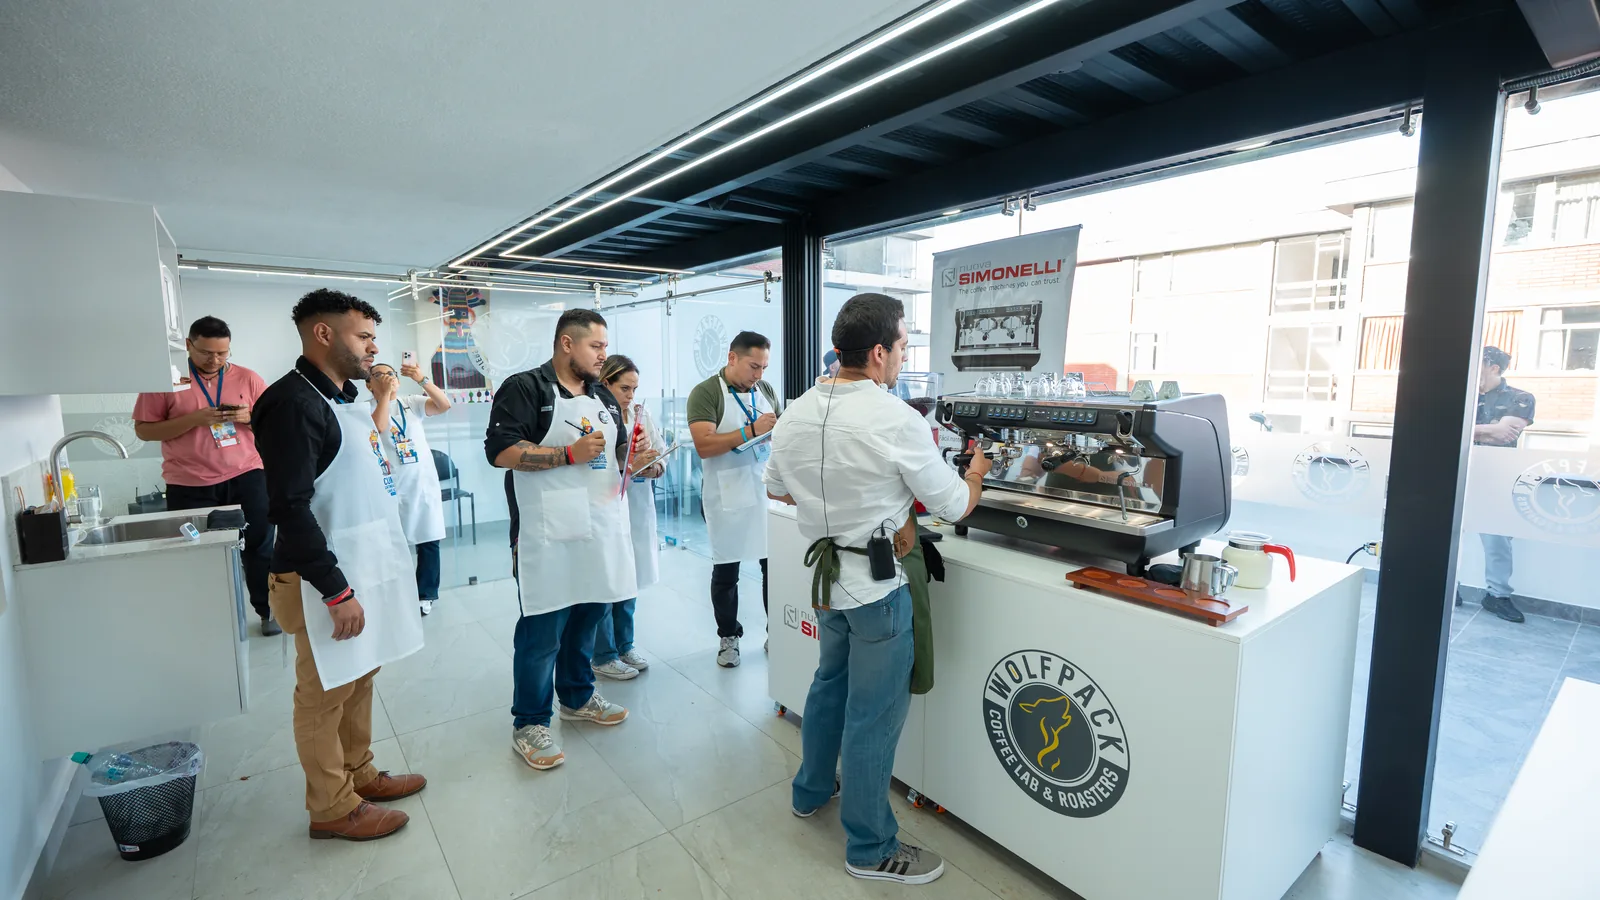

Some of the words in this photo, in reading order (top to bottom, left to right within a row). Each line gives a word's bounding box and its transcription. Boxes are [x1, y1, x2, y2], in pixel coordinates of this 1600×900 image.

[958, 259, 1062, 286] SIMONELLI
[960, 261, 991, 273] nuova
[970, 286, 987, 294] coffee
[988, 282, 1016, 291] machines
[1016, 281, 1028, 289] you
[988, 655, 1124, 754] WOLFPACK
[989, 708, 1017, 766] COFFEE
[1013, 764, 1040, 793] LAB
[1042, 787, 1054, 803] &
[1058, 767, 1119, 809] ROASTERS
